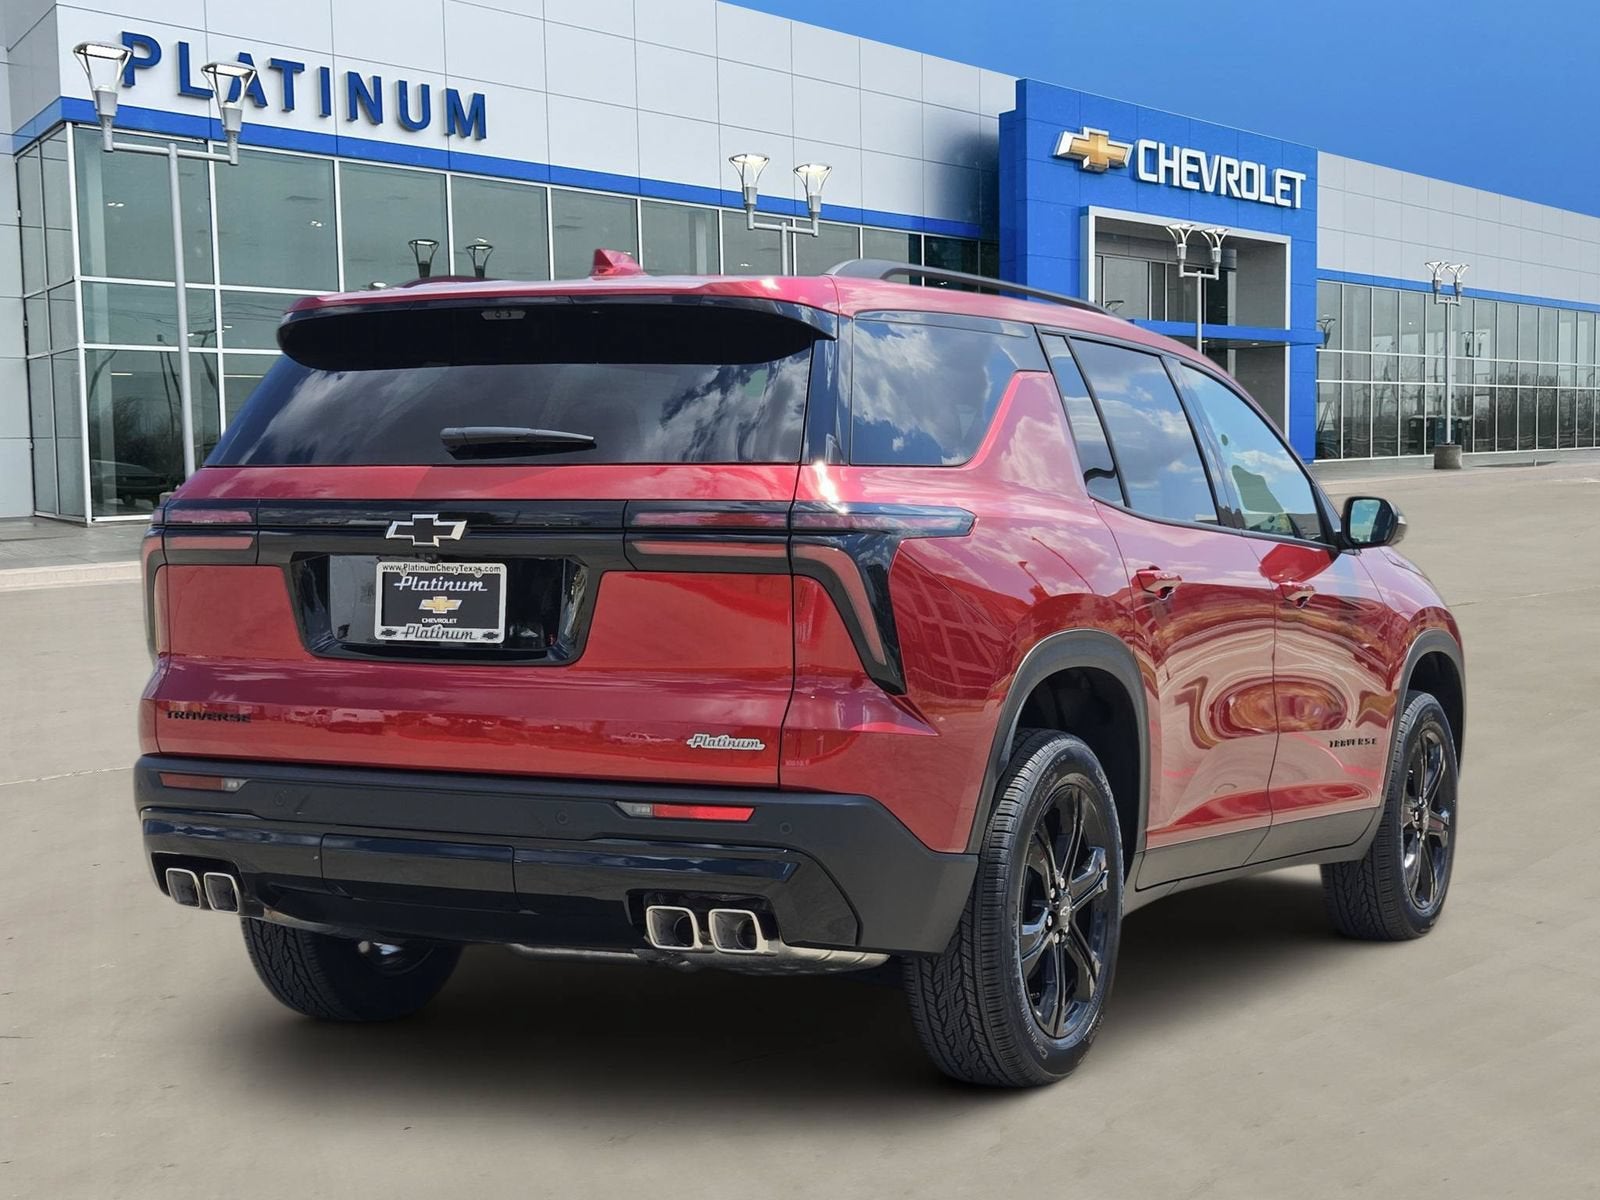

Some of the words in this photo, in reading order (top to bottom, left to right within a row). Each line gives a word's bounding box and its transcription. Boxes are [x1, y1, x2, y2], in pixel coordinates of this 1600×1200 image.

[122, 31, 487, 140] PLATINUM
[1136, 138, 1306, 209] CHEVROLET
[393, 575, 488, 592] Platinum
[421, 617, 458, 625] CHEVROLET
[400, 625, 478, 640] Platinum
[167, 710, 252, 723] TRAVERSE
[687, 734, 765, 750] Platinum
